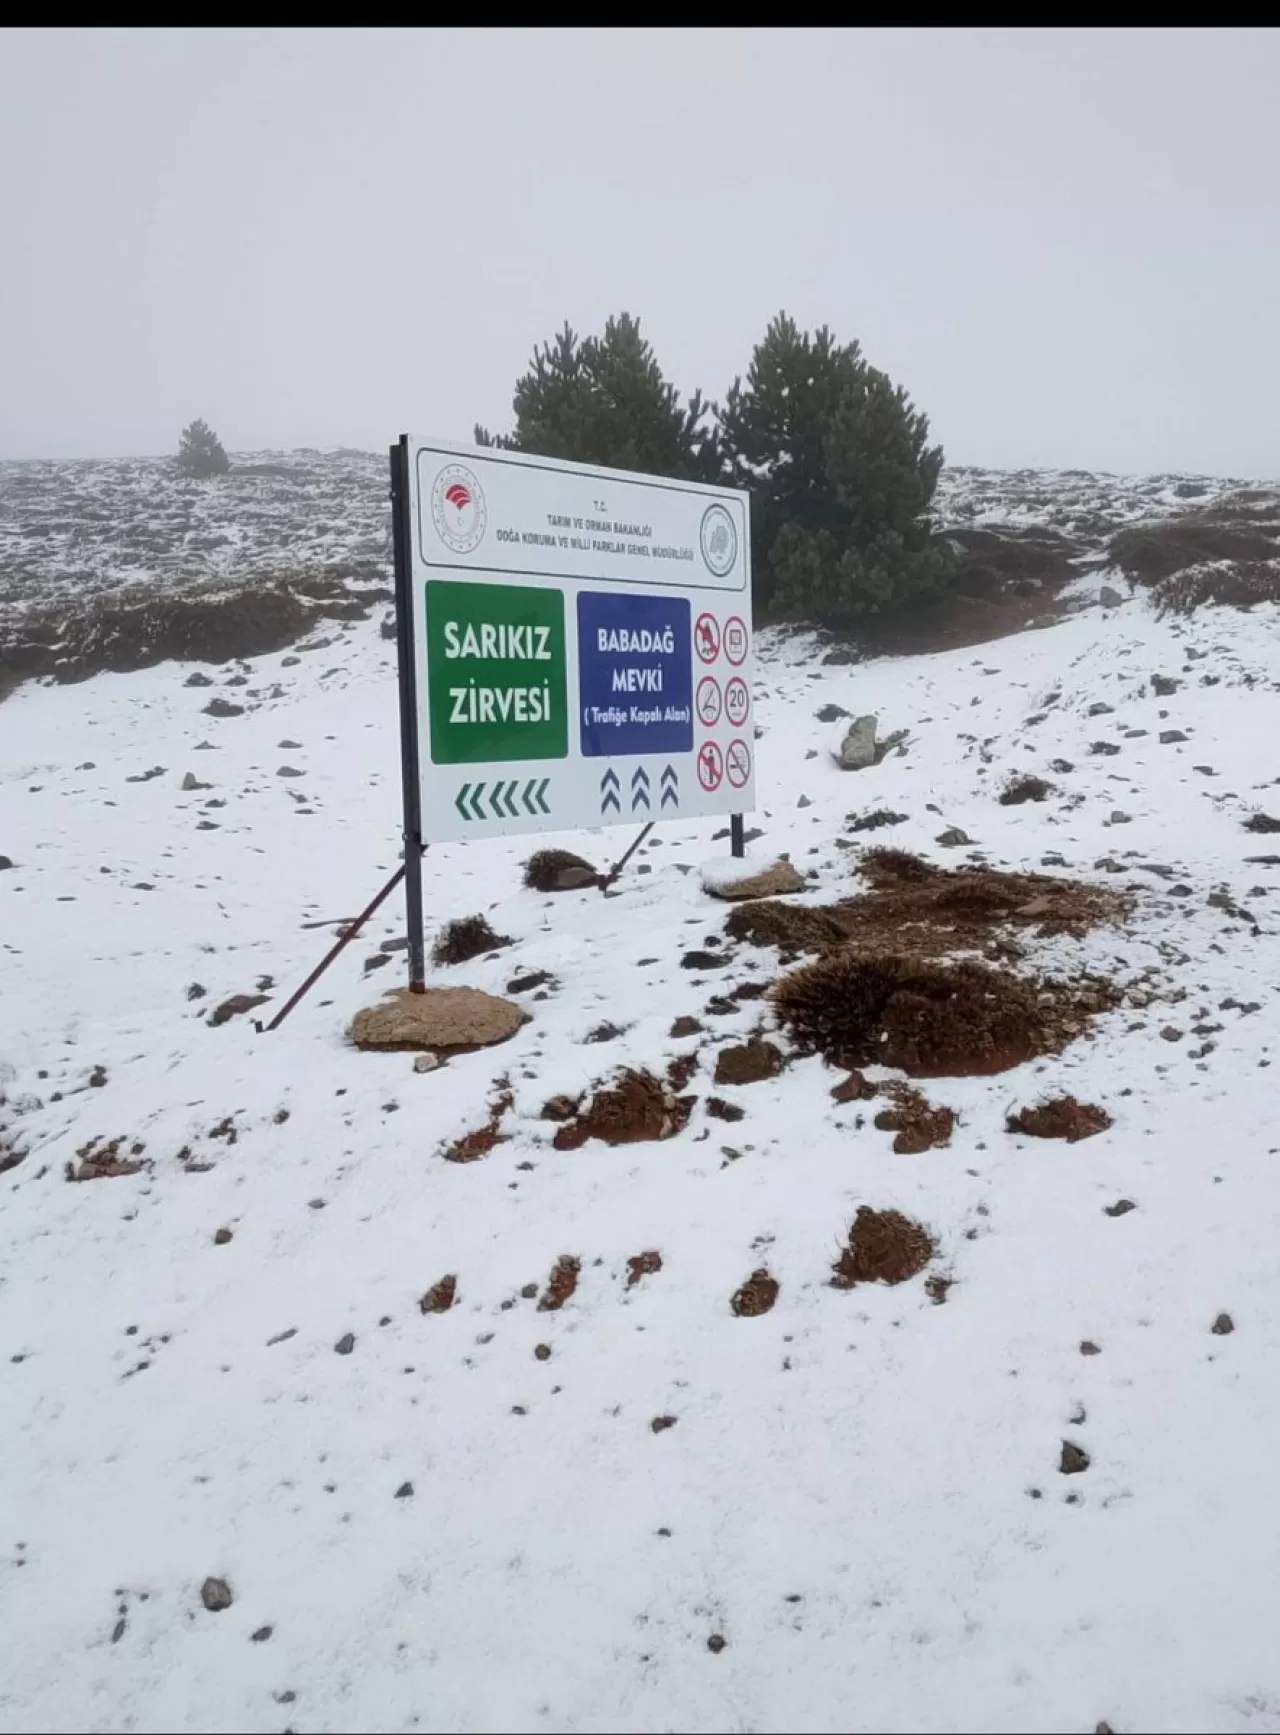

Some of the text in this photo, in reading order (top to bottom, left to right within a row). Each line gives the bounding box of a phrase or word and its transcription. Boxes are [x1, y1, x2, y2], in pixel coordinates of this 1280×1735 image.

[593, 500, 608, 513] T.C.
[547, 514, 571, 528] TARIM
[573, 518, 584, 530] VE
[585, 519, 613, 533] ORMAN
[496, 527, 520, 543] DOĞA
[522, 532, 556, 546] KORUMA
[558, 536, 569, 549] VE
[592, 540, 626, 554] PARKLAR
[627, 544, 650, 557] GENEL
[444, 621, 552, 660] SARIKIZ
[597, 625, 675, 654] BABADAĞ
[612, 663, 663, 692] MEVKİ
[449, 678, 551, 724] ZİRVESİ
[729, 689, 744, 708] 20
[630, 705, 662, 727] Kapalı
[664, 705, 690, 724] Alan)
